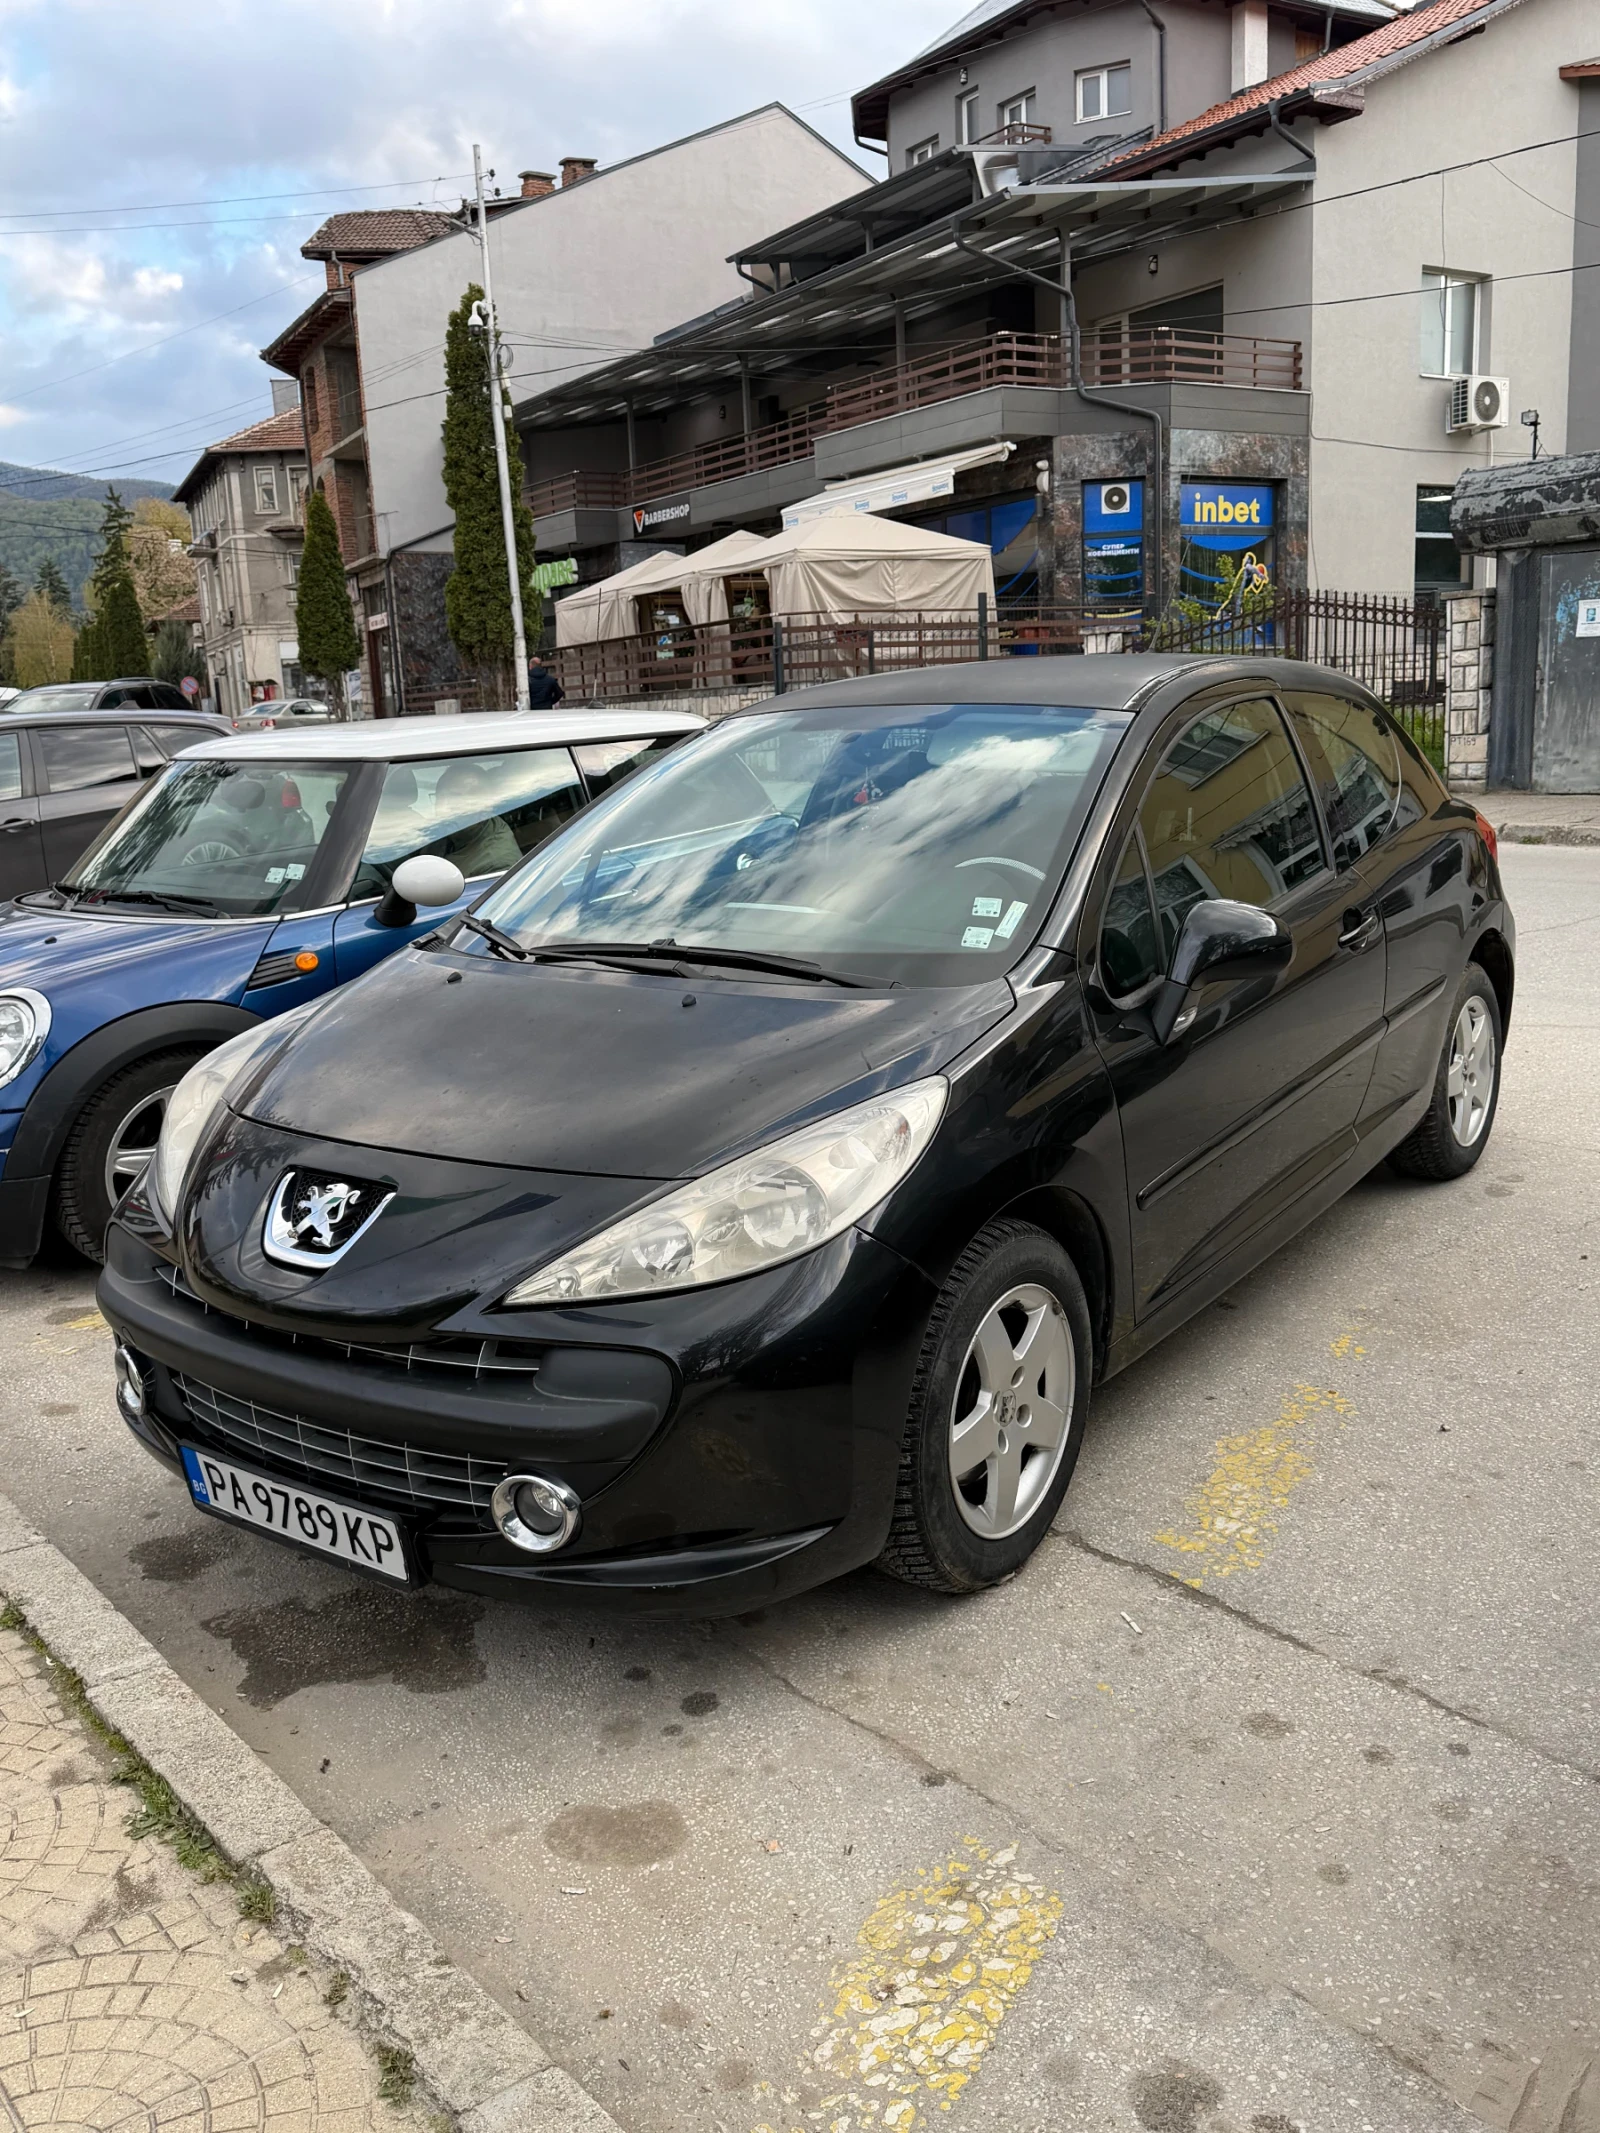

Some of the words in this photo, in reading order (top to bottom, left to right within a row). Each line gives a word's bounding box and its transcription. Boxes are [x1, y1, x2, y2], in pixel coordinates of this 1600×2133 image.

[644, 503, 690, 526] BARBERSHOP
[1194, 492, 1260, 523] inbet
[1102, 543, 1126, 551] СУПЕР
[192, 1479, 208, 1495] BG
[202, 1460, 394, 1565] PA9789KP
